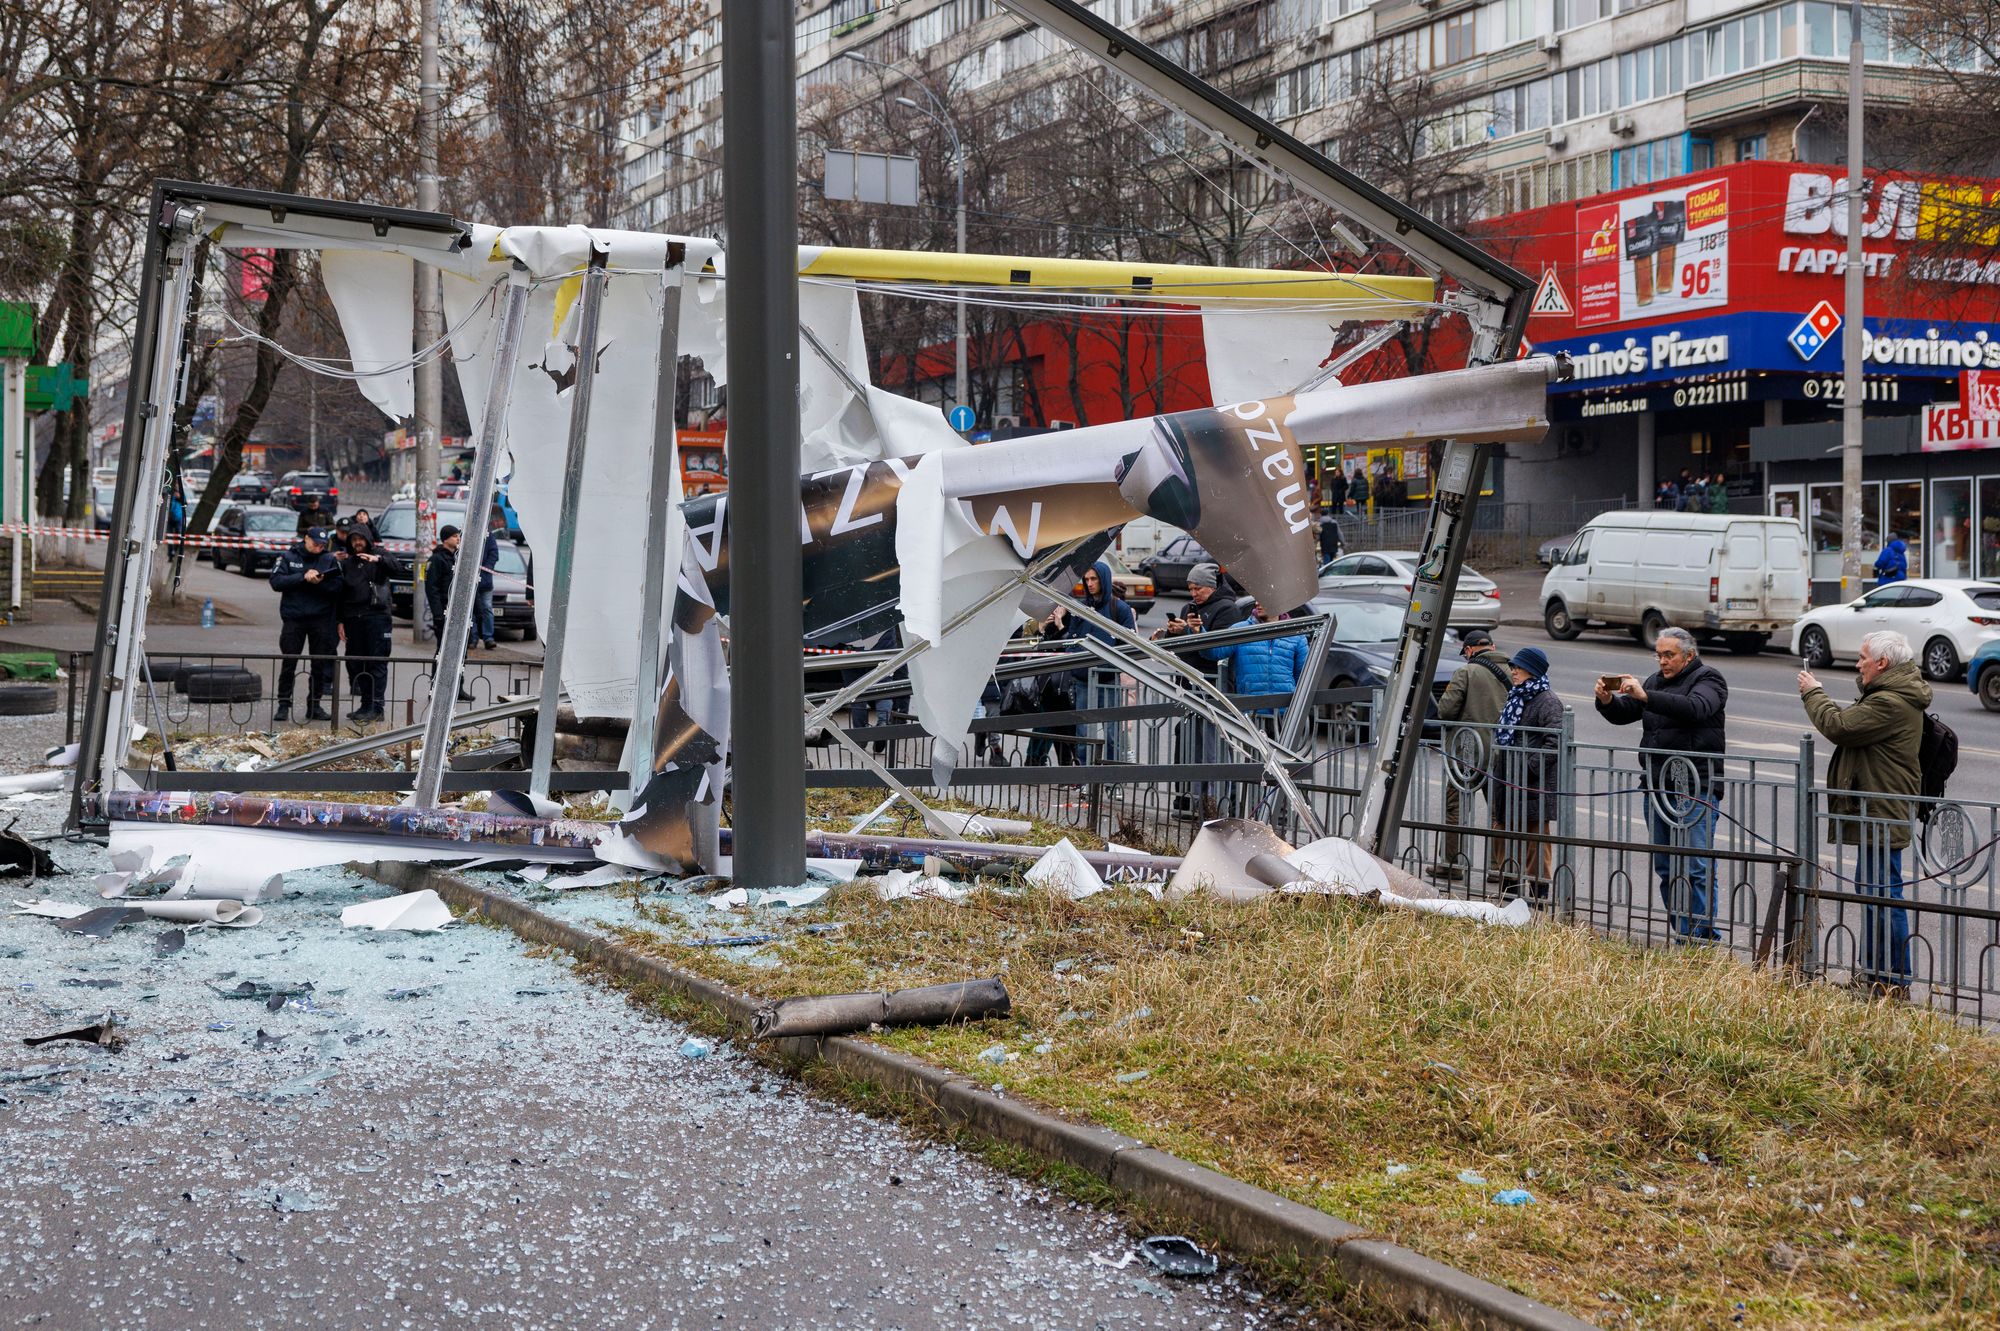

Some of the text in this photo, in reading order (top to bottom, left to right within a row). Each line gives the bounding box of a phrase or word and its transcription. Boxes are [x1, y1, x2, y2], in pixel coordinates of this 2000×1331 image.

[1689, 188, 1721, 208] ТОВАР
[1689, 202, 1727, 224] ТИЖНЯ!
[1681, 259, 1711, 299] 96
[1573, 331, 1728, 380] mino's Pizza
[1688, 381, 1747, 406] 2221111
[1822, 379, 1899, 401] 221111
[1979, 383, 2000, 408] К
[1582, 398, 1647, 417] dominos.ua
